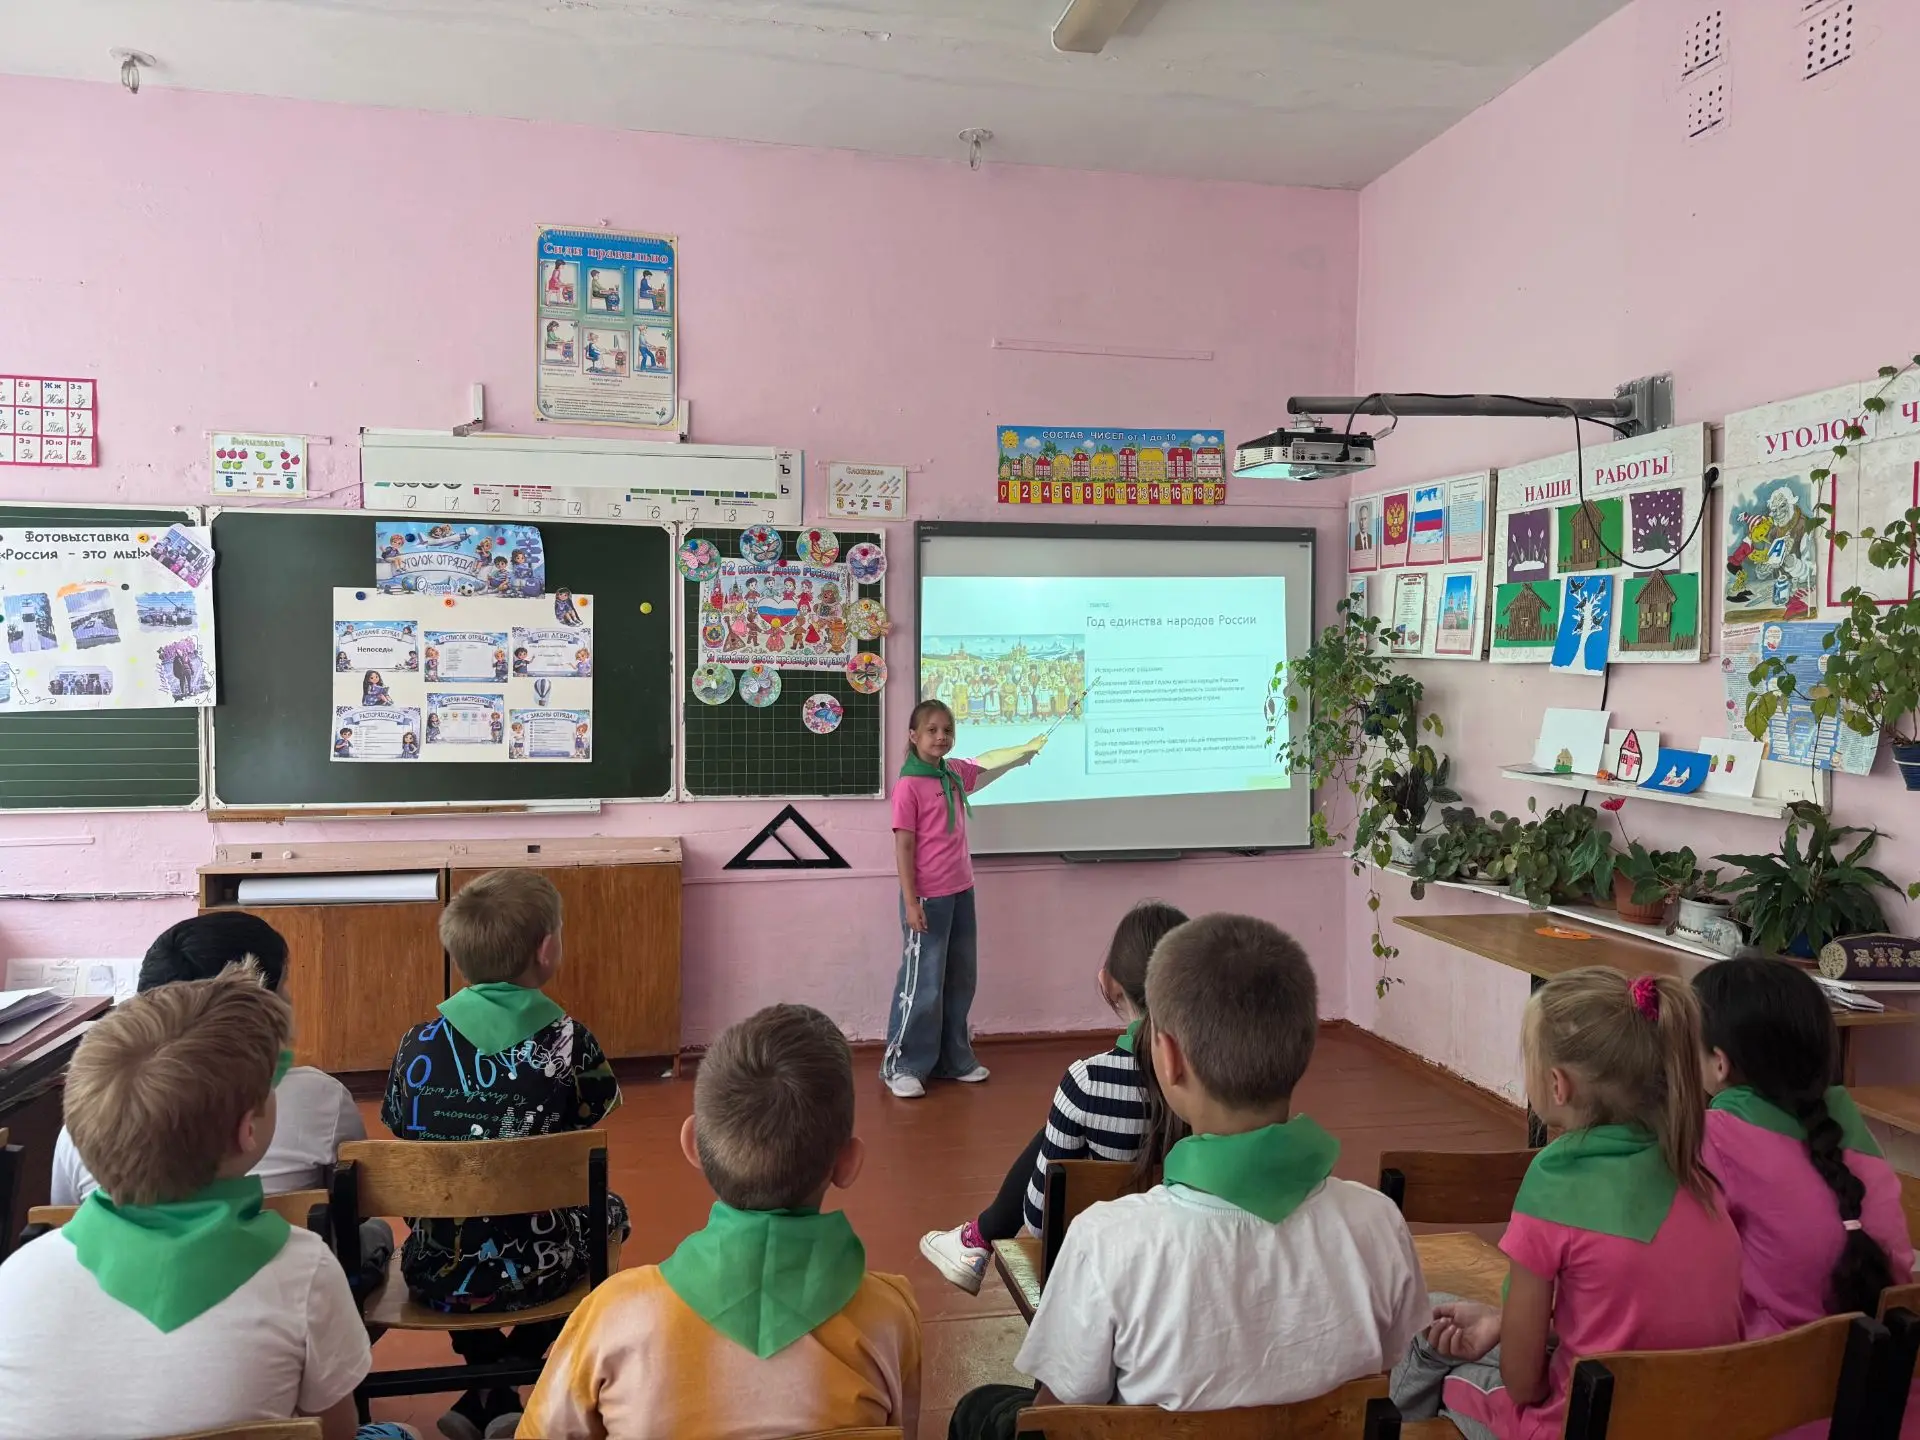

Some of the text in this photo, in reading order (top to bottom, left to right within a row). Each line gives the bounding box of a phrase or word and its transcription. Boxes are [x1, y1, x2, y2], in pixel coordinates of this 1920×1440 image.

[543, 242, 668, 264] Сиди правильно
[1042, 431, 1083, 439] СОСТАВ
[1090, 431, 1124, 440] ЧИСЕЛ
[1150, 434, 1162, 442] до
[1166, 433, 1176, 441] 10
[1765, 415, 1869, 454] УГОЛОК
[1595, 455, 1669, 487] РАБОТЫ
[225, 475, 233, 487] 5
[256, 476, 264, 488] 2
[286, 477, 294, 489] 3
[1001, 485, 1007, 497] 0
[1012, 485, 1017, 497] 1
[1022, 485, 1029, 498] 2
[1033, 485, 1039, 498] 3
[1043, 485, 1050, 498] 4
[1054, 486, 1060, 498] 5
[1064, 486, 1070, 498] 6
[1075, 486, 1081, 499] 7
[1085, 486, 1091, 498] 8
[1096, 486, 1102, 499] 9
[1105, 487, 1114, 499] 10
[1127, 487, 1136, 499] 12
[1149, 487, 1158, 499] 14
[1160, 487, 1169, 500] 15
[1171, 487, 1180, 499] 16
[1194, 487, 1203, 499] 18
[1215, 488, 1224, 500] 20
[1524, 478, 1572, 502] НАШИ
[407, 495, 774, 522] 0 1 2 3 4 5 6 7 8 9
[836, 497, 845, 509] 3
[860, 498, 868, 510] 2
[884, 499, 892, 511] 5
[25, 531, 129, 542] Фотовыставка
[83, 551, 107, 559] это
[113, 547, 151, 559] мы!»
[401, 553, 474, 571] УГОЛОК ОТРЯДА
[721, 561, 735, 575] 12
[1086, 615, 1256, 628] Год единства народов России
